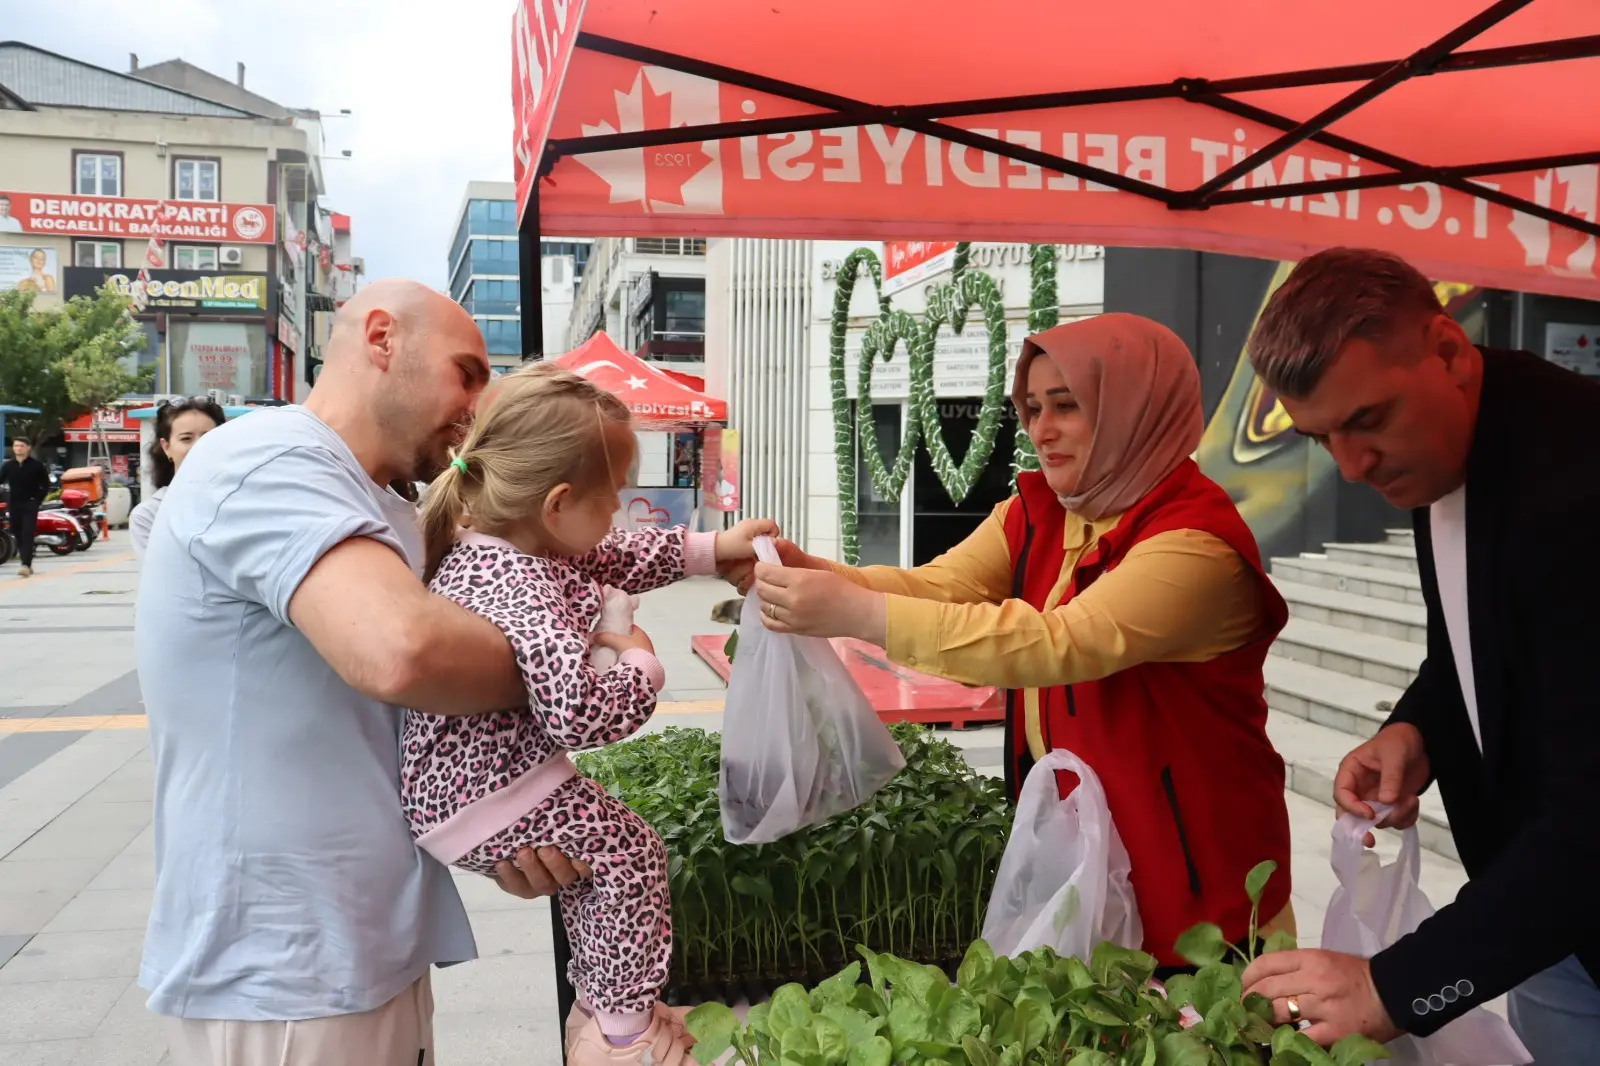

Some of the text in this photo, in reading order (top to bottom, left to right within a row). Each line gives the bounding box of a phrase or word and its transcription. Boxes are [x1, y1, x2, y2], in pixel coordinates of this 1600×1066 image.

[30, 199, 228, 224] DEMOKRAT PARTİ
[30, 218, 104, 232] KOCAELİ
[109, 220, 124, 233] İL
[629, 402, 690, 415] LEDİYESİ
